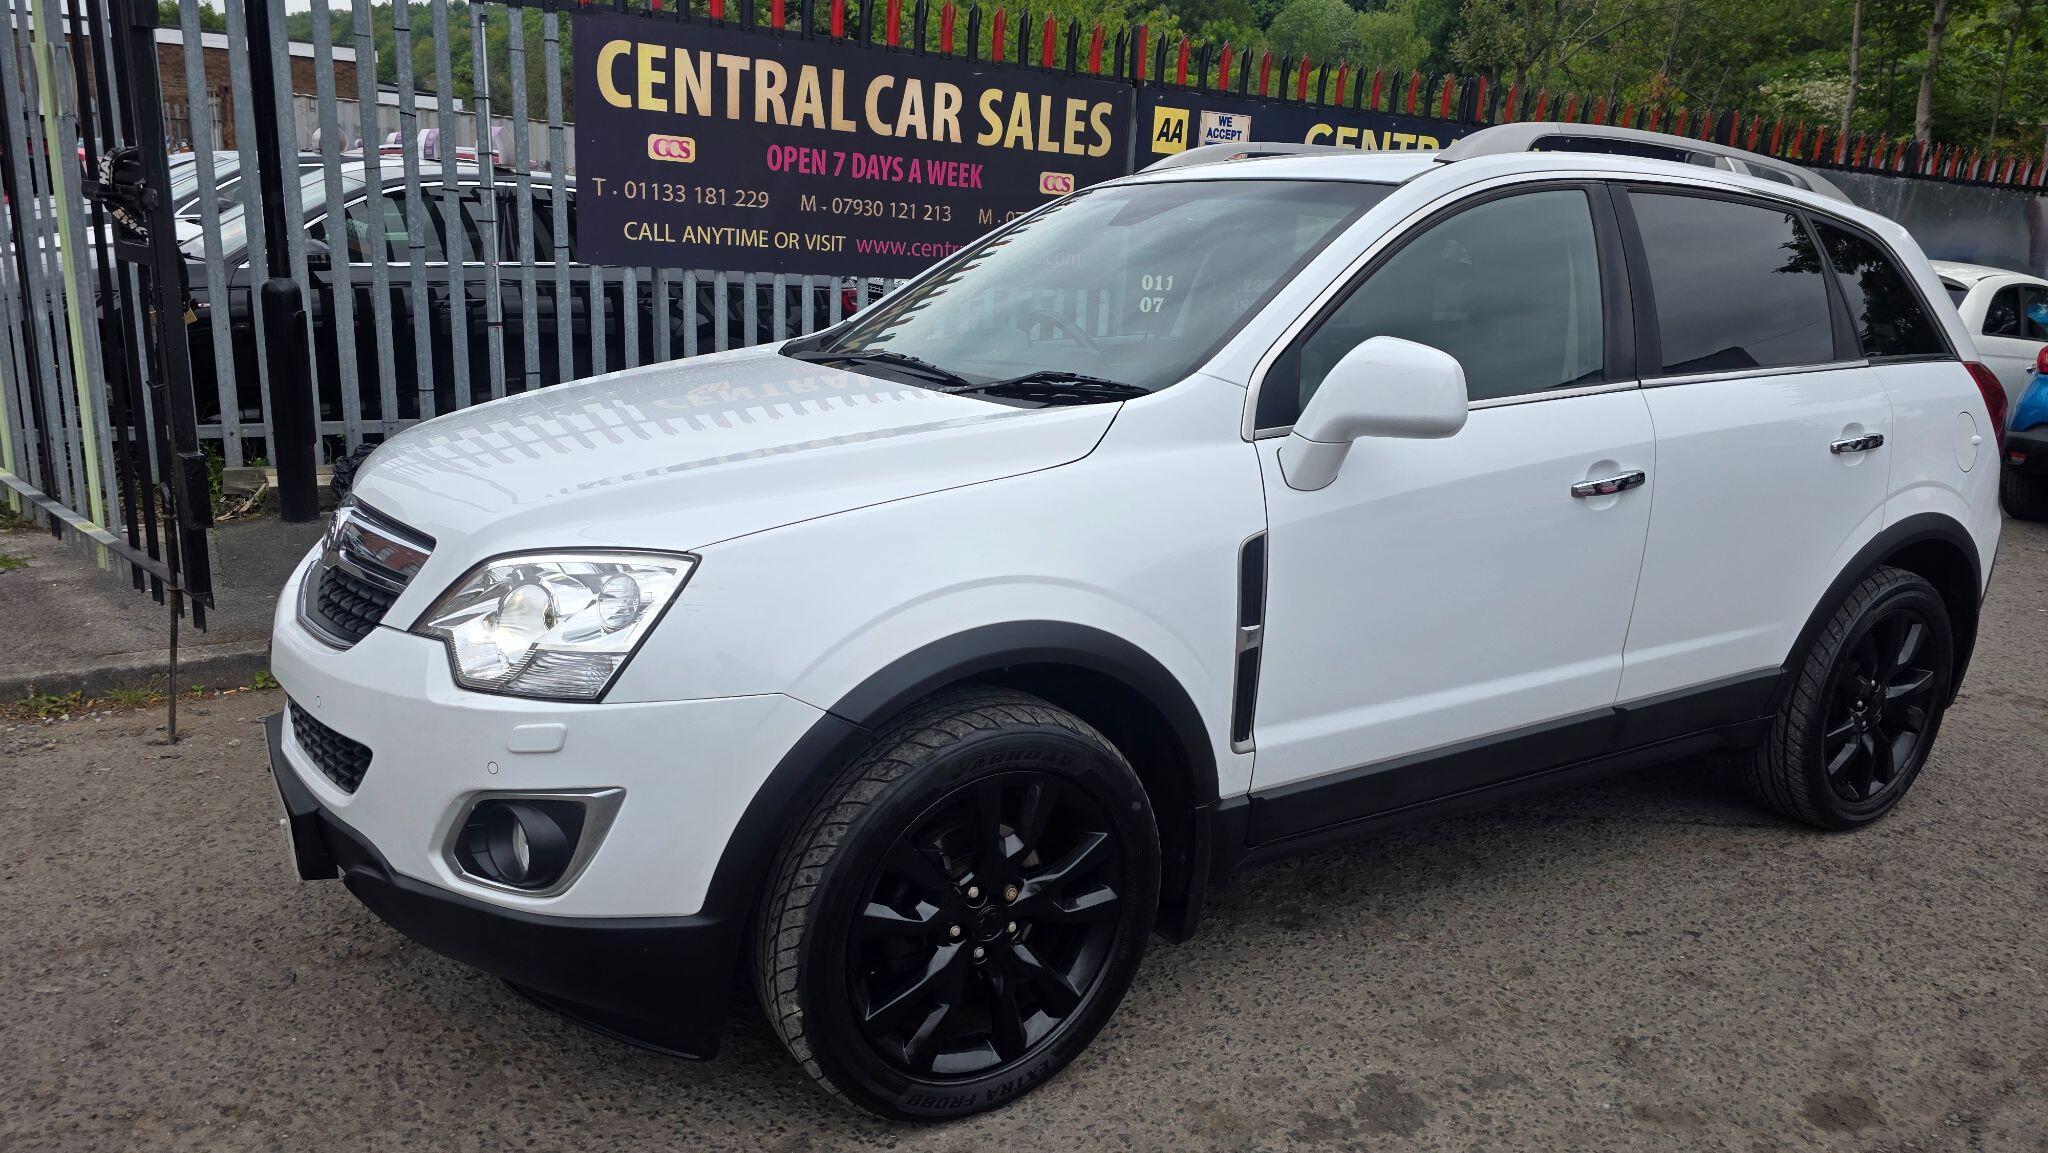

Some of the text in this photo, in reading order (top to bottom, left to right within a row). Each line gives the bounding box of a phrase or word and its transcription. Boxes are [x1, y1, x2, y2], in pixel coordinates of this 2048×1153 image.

[596, 39, 1113, 157] CENTRAL CAR SALES
[1156, 117, 1184, 144] AA
[1206, 127, 1243, 141] ACCEPT
[1218, 115, 1233, 127] WE
[653, 138, 691, 159] CCS
[766, 144, 984, 189] OPEN 7 DAYS A WEEK
[624, 180, 686, 202] 01133
[694, 186, 726, 206] 181
[732, 189, 769, 208] 229
[832, 197, 884, 217] 07930
[890, 202, 916, 219] 121
[923, 204, 951, 222] 213
[623, 221, 676, 243] CALL
[682, 225, 769, 248] ANYTIME
[774, 231, 800, 249] OR
[804, 233, 846, 252] VISIT
